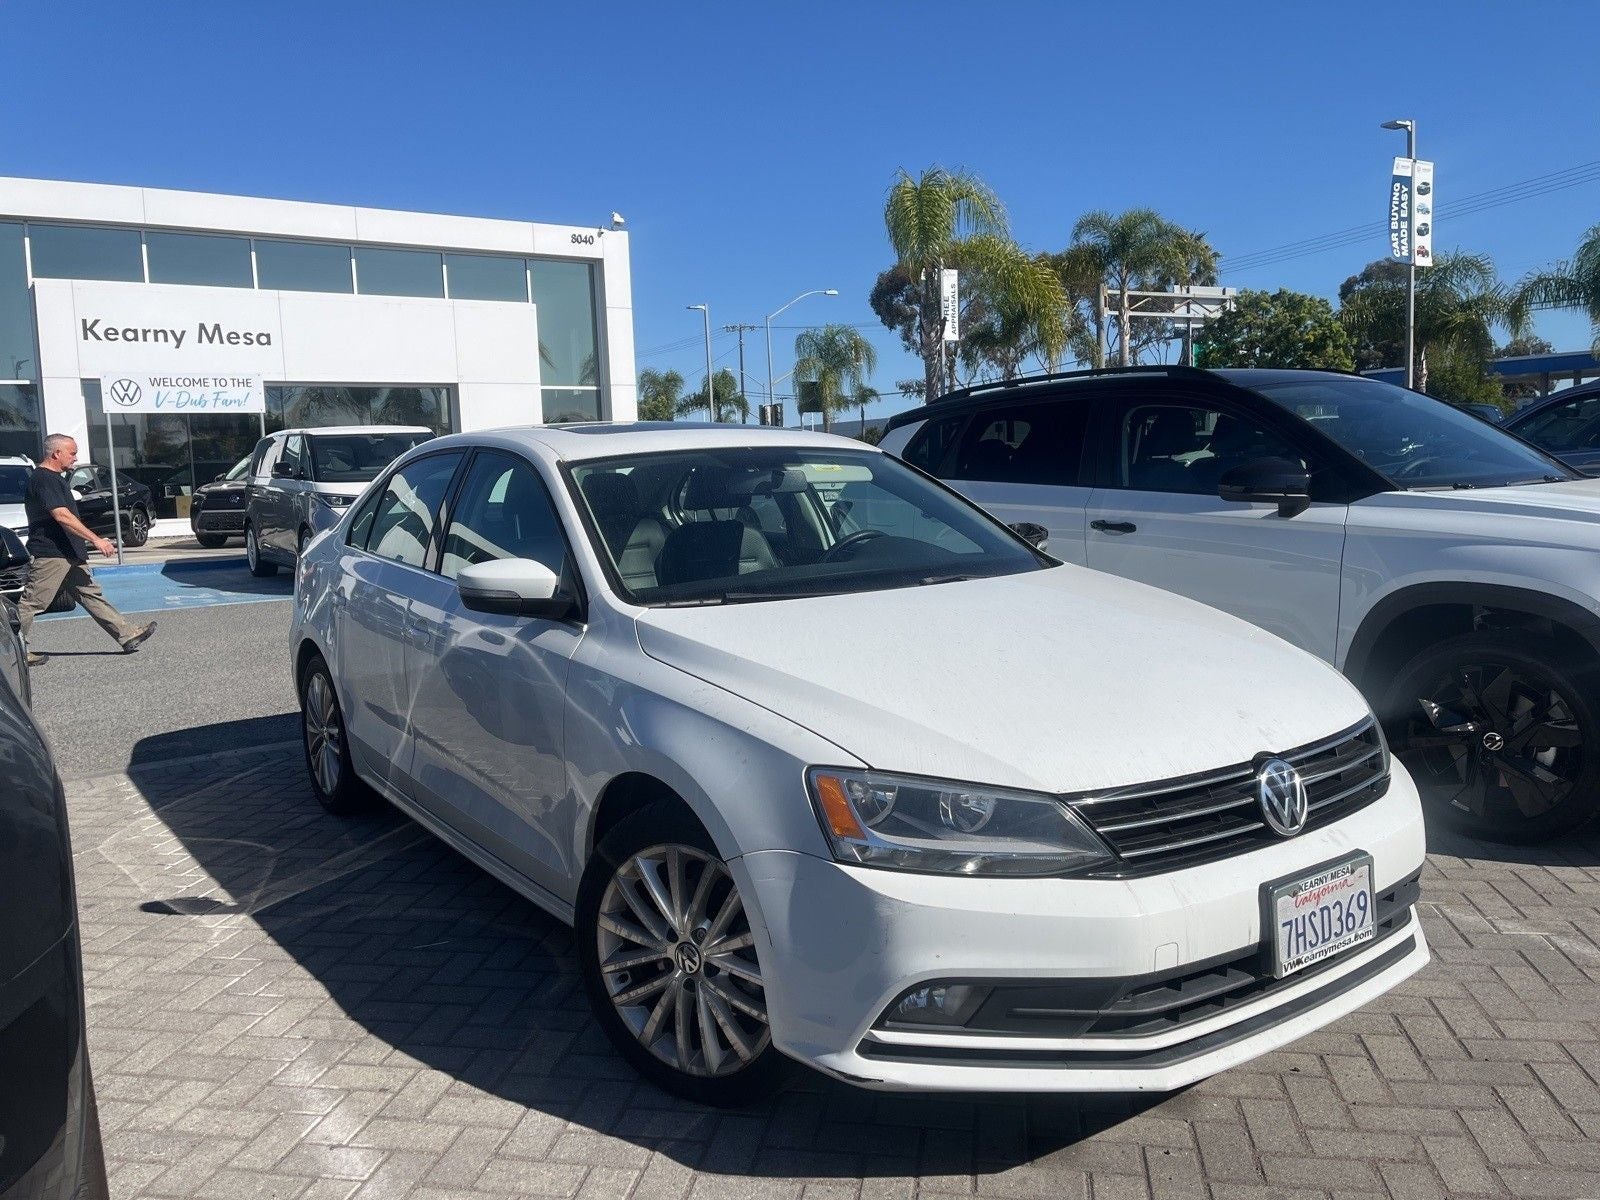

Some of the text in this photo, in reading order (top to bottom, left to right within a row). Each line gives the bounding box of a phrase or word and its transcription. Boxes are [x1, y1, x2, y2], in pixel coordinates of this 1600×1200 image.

[1391, 182, 1401, 257] CAR BUYING
[1400, 185, 1409, 257] MADE EASY
[571, 233, 594, 245] 8040
[81, 318, 272, 349] Kearny Mesa
[149, 377, 252, 388] WELCOME TO THE
[155, 390, 250, 409] V-Dub Fam!
[1299, 865, 1351, 893] KEARNY MESA
[1281, 889, 1368, 960] 7HSD369
